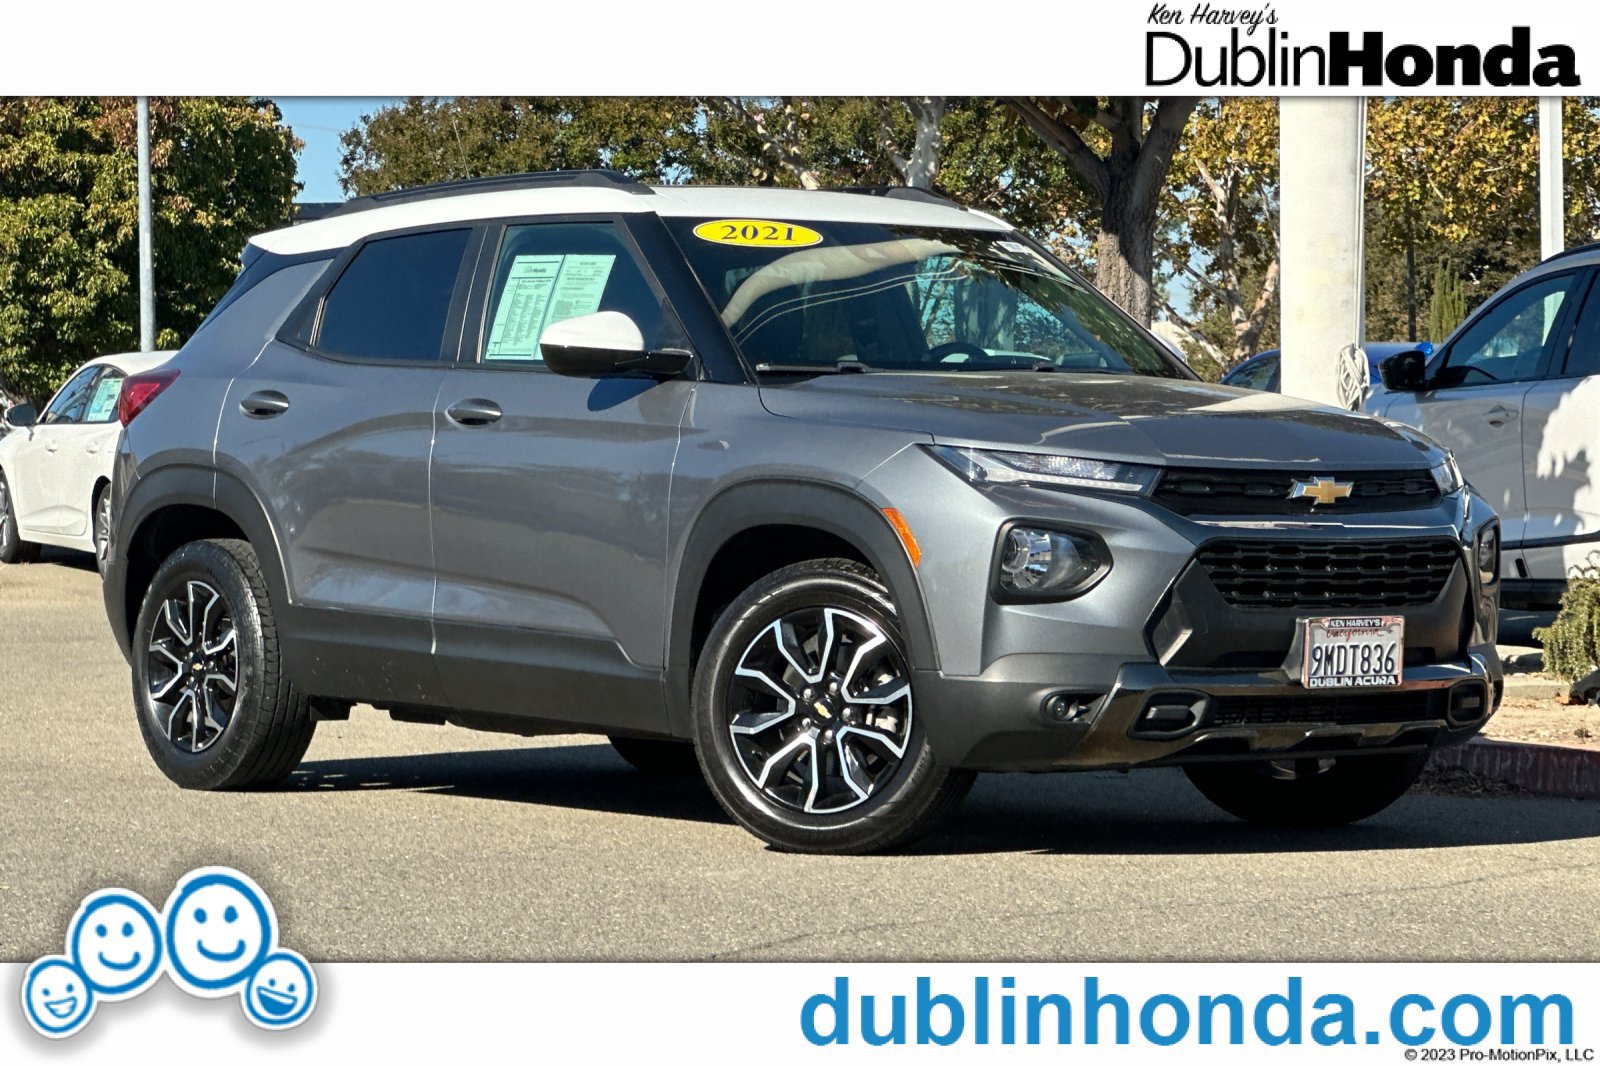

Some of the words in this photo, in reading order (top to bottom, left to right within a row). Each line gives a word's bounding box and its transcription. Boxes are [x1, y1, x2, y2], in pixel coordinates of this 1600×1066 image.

[721, 225, 796, 241] 2021
[1331, 619, 1343, 627] KEN
[1346, 619, 1381, 627] HARVEY'S
[1311, 643, 1396, 676] 9MDT836
[1309, 676, 1353, 688] DUBLIN
[1354, 676, 1396, 686] ACURA
